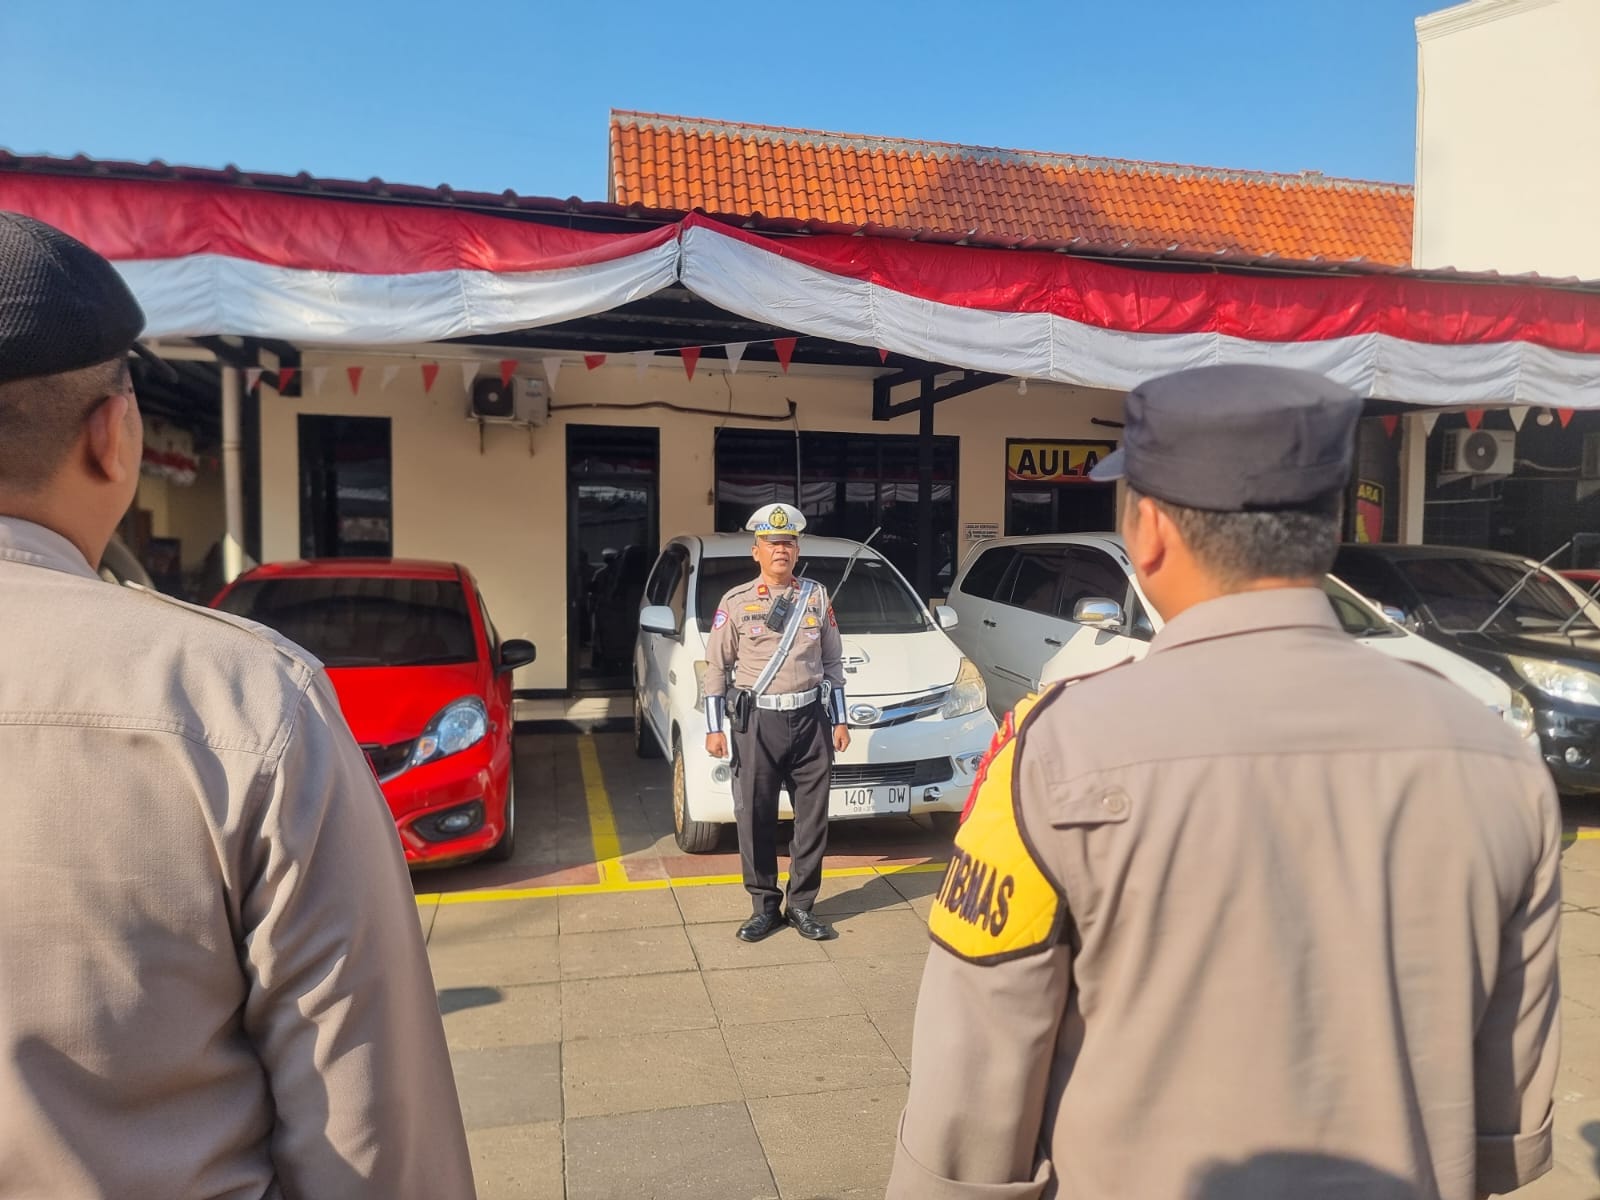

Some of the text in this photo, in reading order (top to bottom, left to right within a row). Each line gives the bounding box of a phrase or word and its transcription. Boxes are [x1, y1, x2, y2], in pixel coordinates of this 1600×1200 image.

[1017, 449, 1099, 476] AULA
[845, 787, 906, 806] 1407 DW
